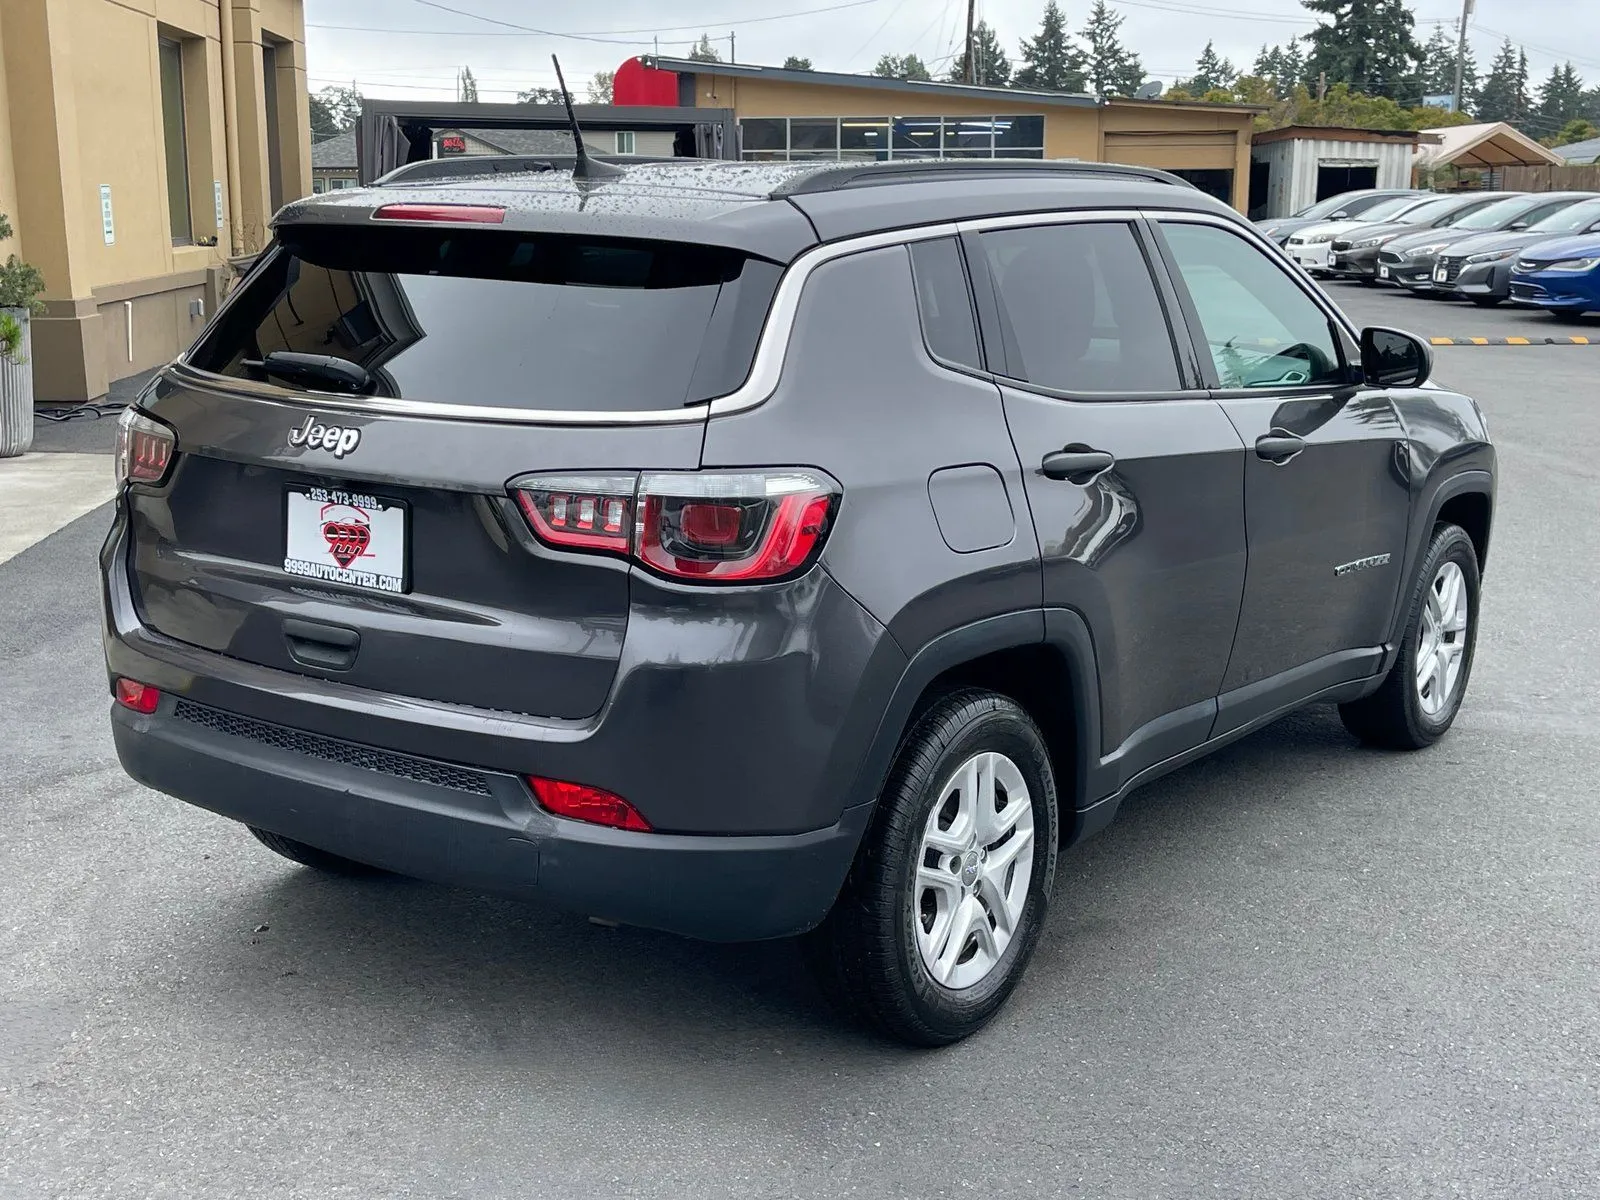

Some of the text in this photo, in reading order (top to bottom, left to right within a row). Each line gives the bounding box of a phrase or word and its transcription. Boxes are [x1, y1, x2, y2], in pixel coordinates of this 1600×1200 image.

[288, 414, 361, 459] Jeep
[310, 487, 377, 509] 253-473-9999
[284, 558, 403, 593] 9999AUTOCENTER.COM
